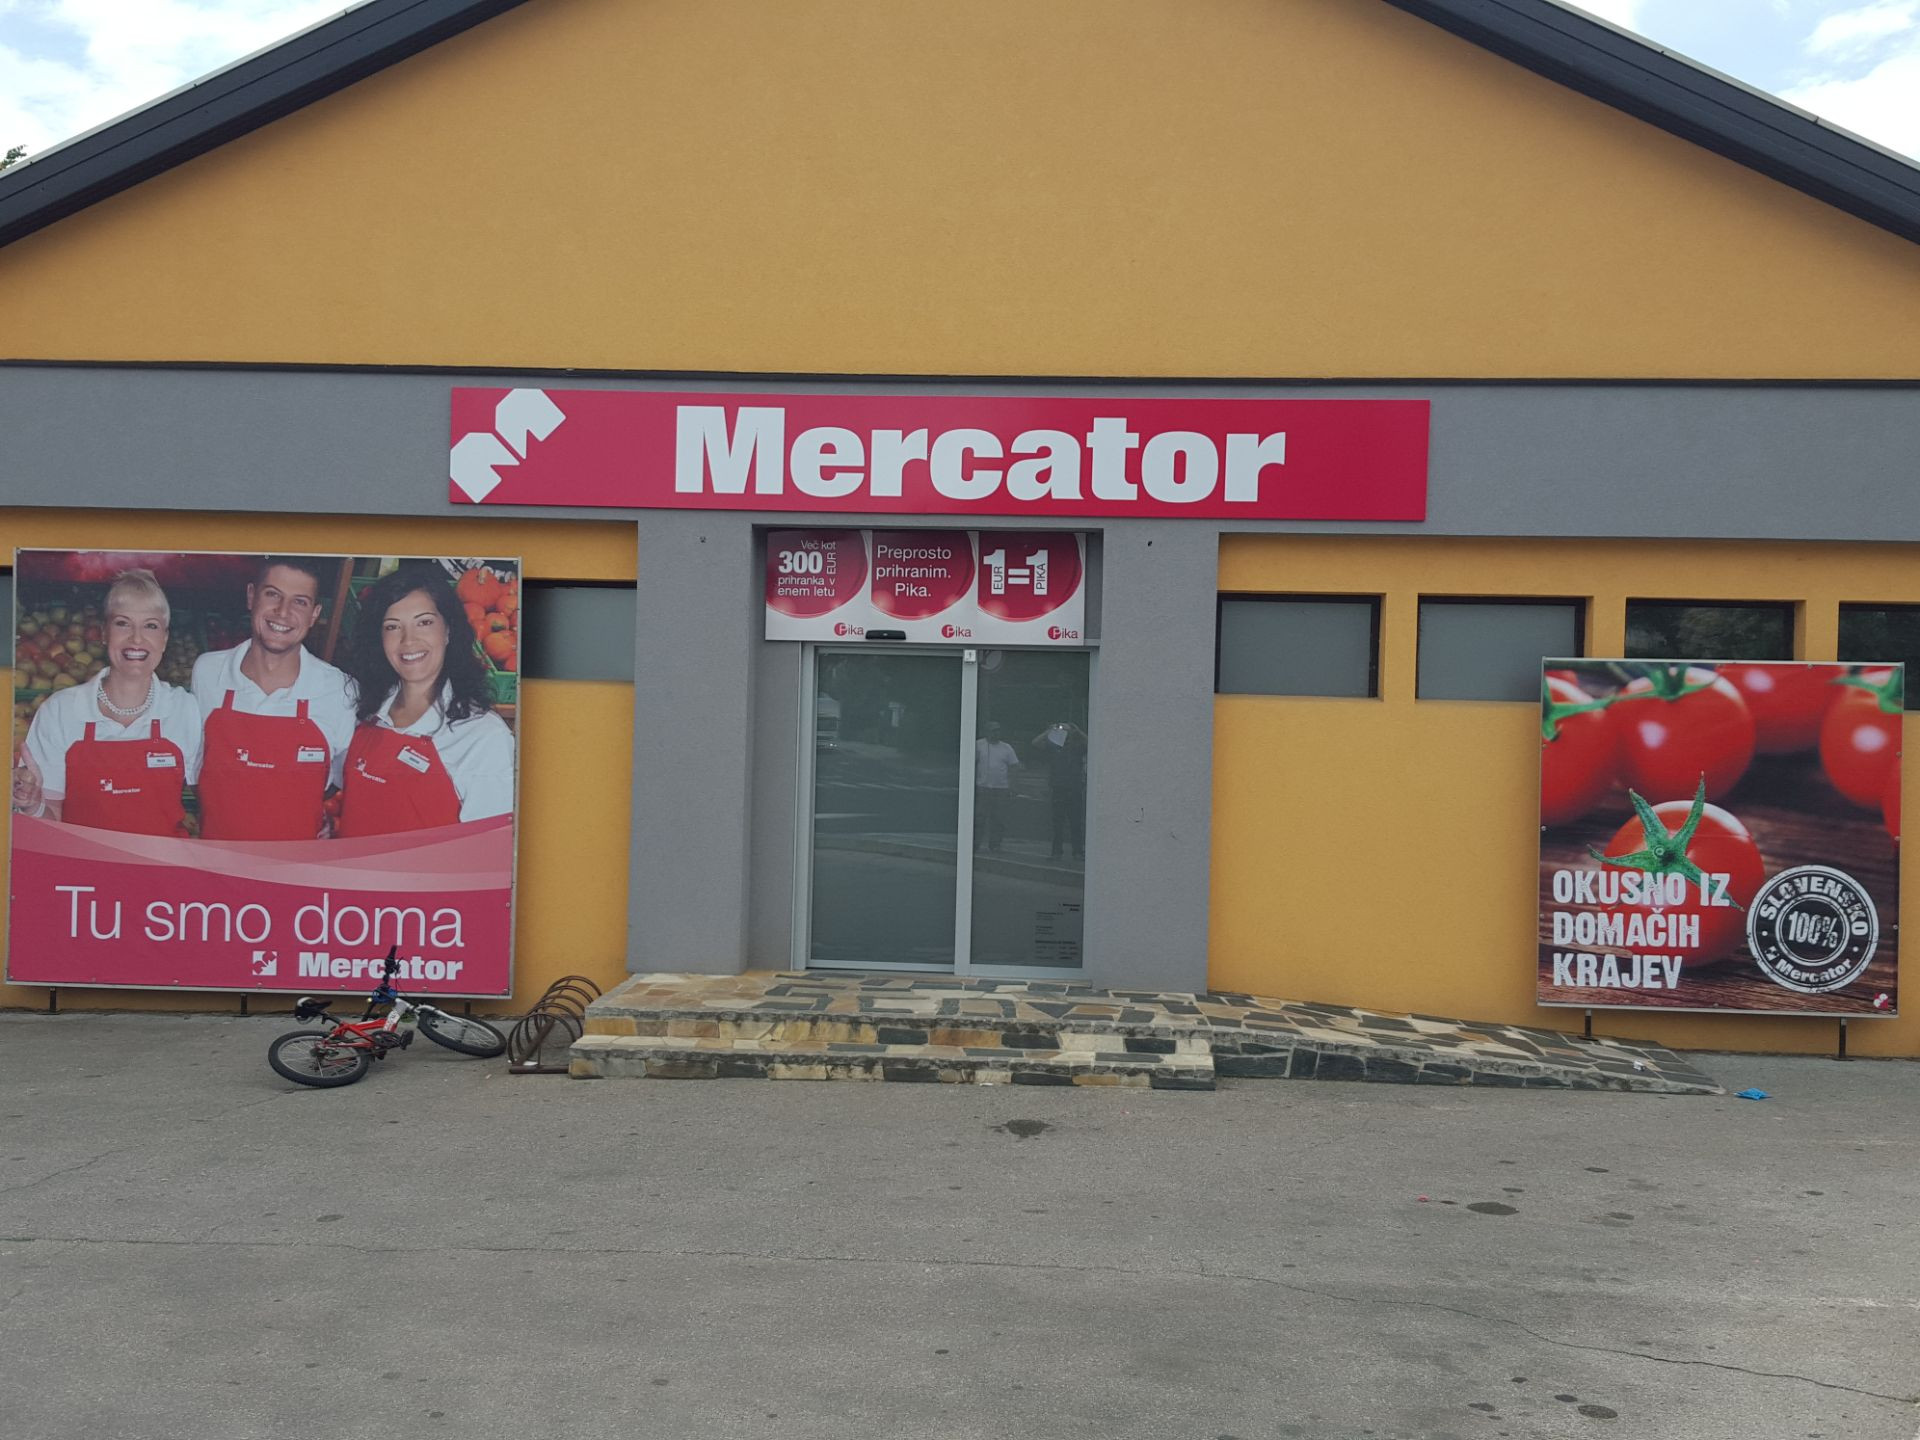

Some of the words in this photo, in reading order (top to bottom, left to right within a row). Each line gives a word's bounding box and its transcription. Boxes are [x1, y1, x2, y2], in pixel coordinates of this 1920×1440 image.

[675, 406, 1285, 504] Mercator
[801, 540, 820, 550] Več
[821, 541, 837, 550] kot
[877, 545, 952, 562] Preprosto
[778, 551, 823, 574] 300
[826, 552, 837, 575] EUR
[876, 564, 951, 581] prihranim.
[778, 575, 825, 587] prihranka
[829, 577, 836, 586] v
[993, 566, 1003, 590] EUR
[1036, 563, 1046, 590] PIKA
[777, 587, 810, 597] enem
[813, 586, 835, 597] letu
[895, 583, 932, 597] Pika.
[1553, 870, 1687, 906] OKUSNO
[1699, 873, 1731, 907] IZ
[55, 885, 123, 940] Tu
[144, 899, 272, 944] smo
[293, 892, 465, 949] doma
[1760, 876, 1869, 936] SLOVENSKO
[1553, 908, 1700, 948] DOMAČIH
[1788, 911, 1839, 948] 100%
[1553, 953, 1683, 989] KRAJEV
[1775, 959, 1852, 983] Mercator
